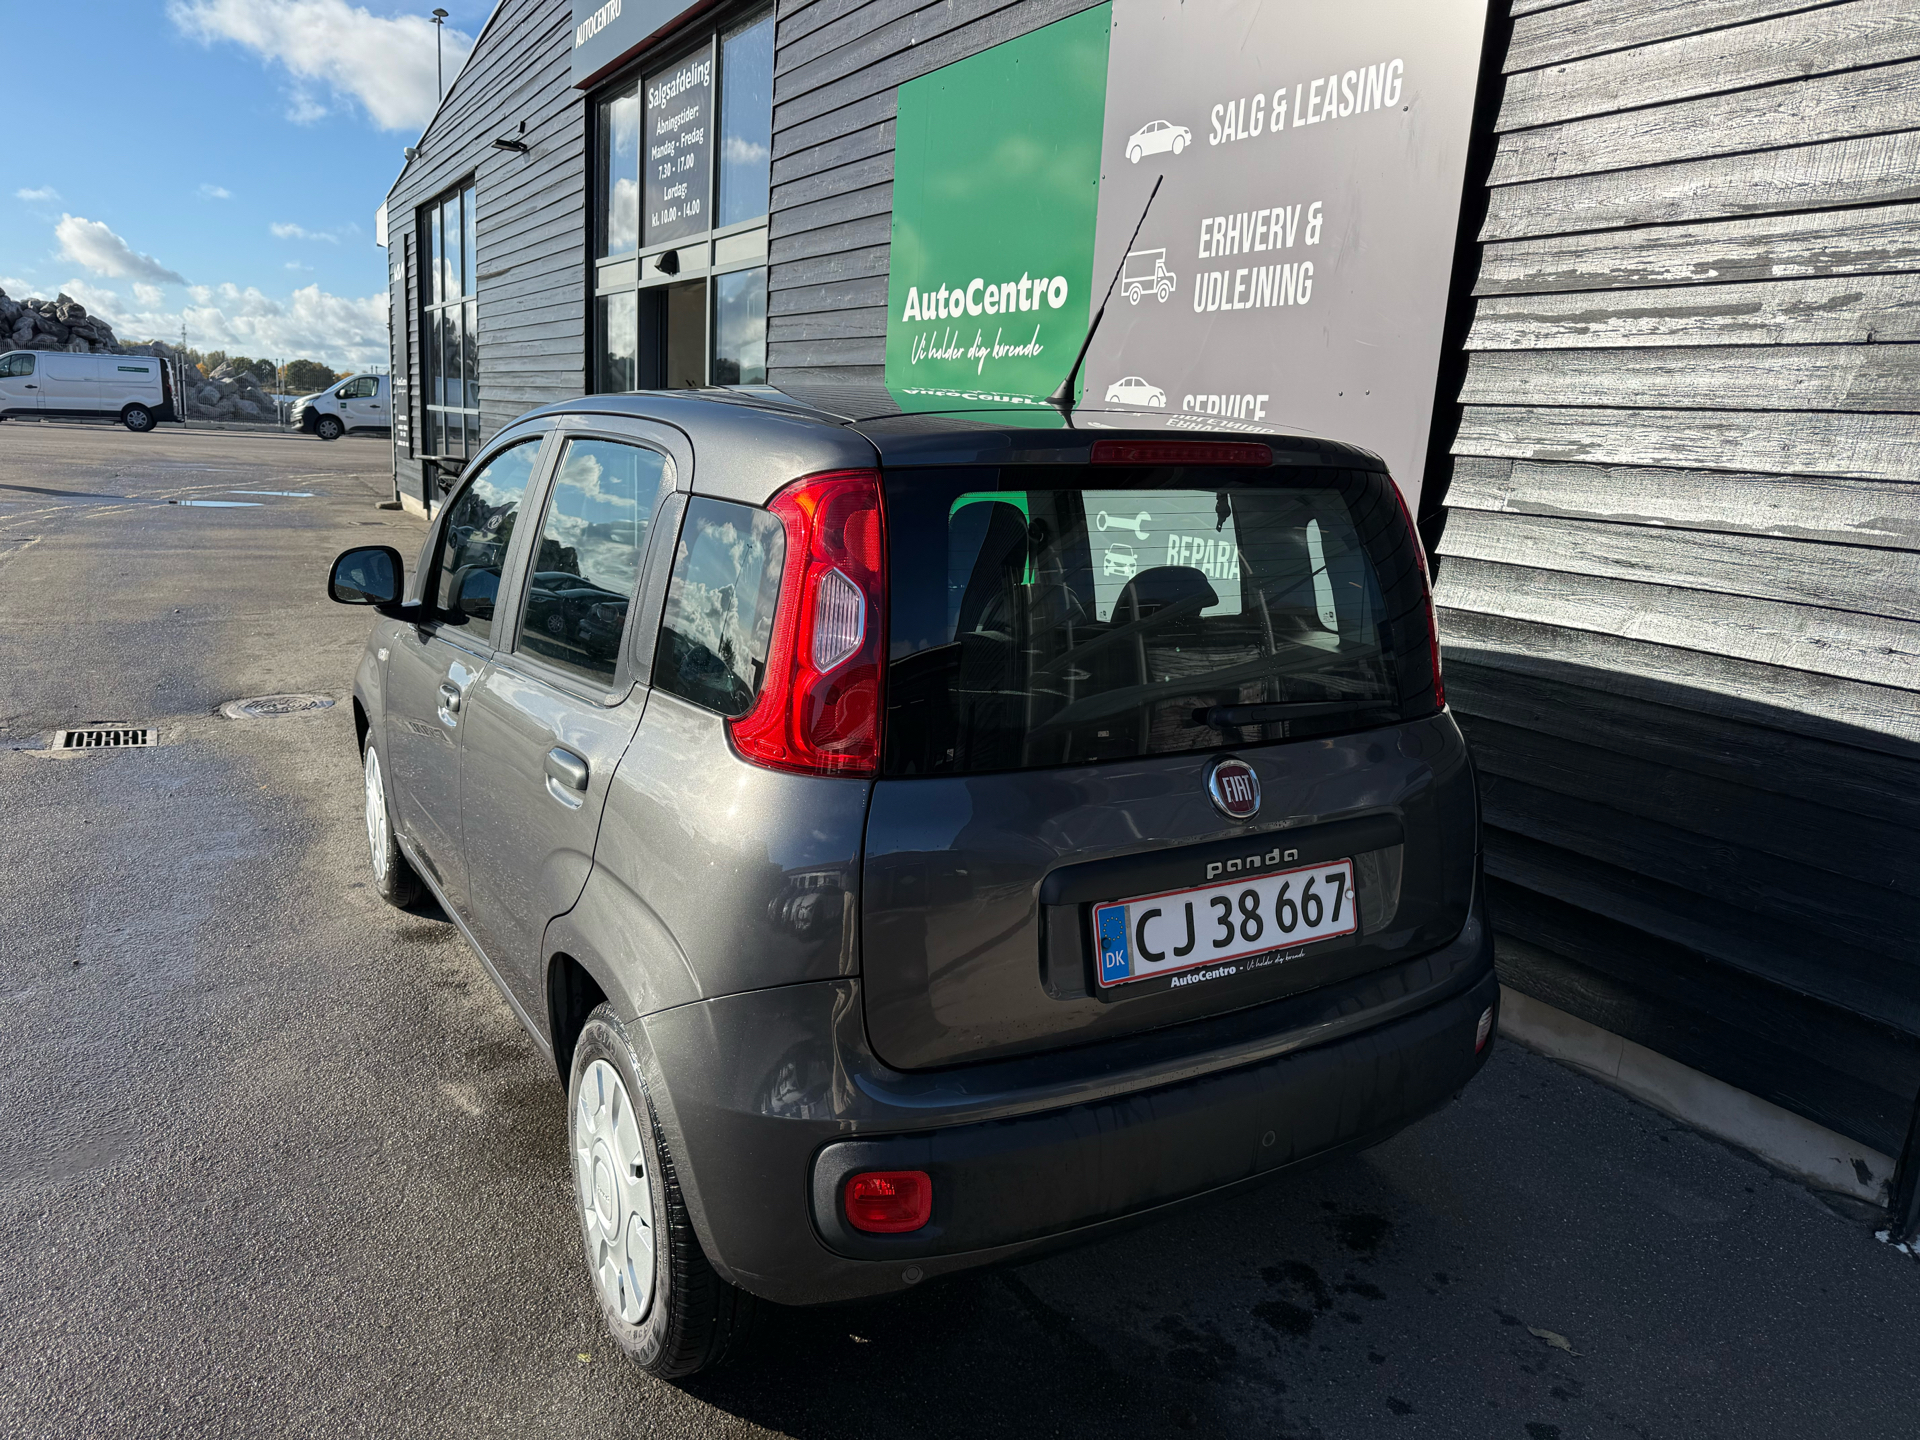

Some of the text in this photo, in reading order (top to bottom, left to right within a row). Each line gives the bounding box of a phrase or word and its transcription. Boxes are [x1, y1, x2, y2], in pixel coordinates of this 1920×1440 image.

[575, 0, 622, 49] AUTOCENTRO
[648, 60, 711, 109] Salgsafdeling
[1208, 58, 1404, 146] SALG & LEASING
[656, 105, 699, 136] Åbningstider:
[651, 140, 675, 161] Mandag
[680, 127, 704, 148] Fredag
[658, 162, 671, 180] 7.30
[677, 152, 695, 173] 17.00
[661, 206, 677, 224] 10.00
[683, 198, 700, 218] 14.00
[1198, 201, 1323, 259] ERHVERV &
[901, 271, 1069, 323] AutoCentro
[1193, 261, 1314, 313] UDLEJNING
[911, 332, 927, 365] Vi
[928, 326, 965, 362] holder
[967, 331, 991, 376] dig
[1222, 774, 1253, 804] FIAT
[1206, 848, 1299, 880] panda
[1135, 871, 1346, 962] CJ 38 667
[1105, 950, 1125, 968] DK
[1170, 965, 1237, 988] AutoCentro
